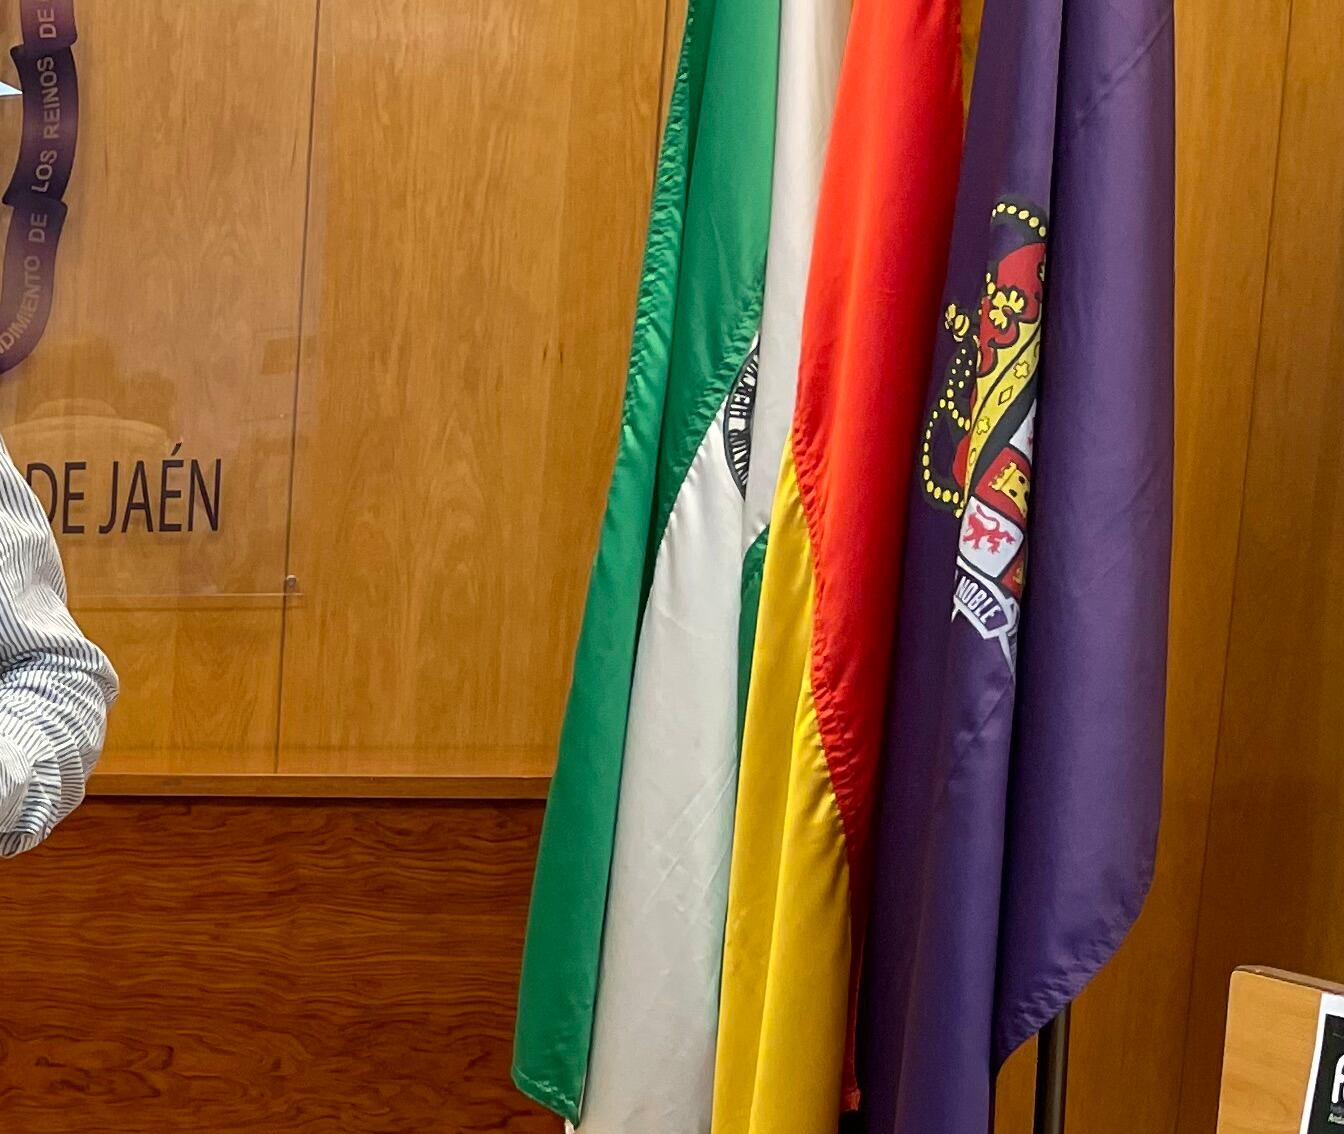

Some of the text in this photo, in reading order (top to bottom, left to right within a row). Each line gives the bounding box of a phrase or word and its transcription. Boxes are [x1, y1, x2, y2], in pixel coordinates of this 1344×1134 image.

[37, 9, 57, 38] DE
[37, 57, 61, 139] REINOS
[32, 150, 57, 192] LOS
[28, 213, 48, 243] DE
[26, 441, 222, 534] DE JAÉN
[955, 575, 1002, 625] NOBLE
